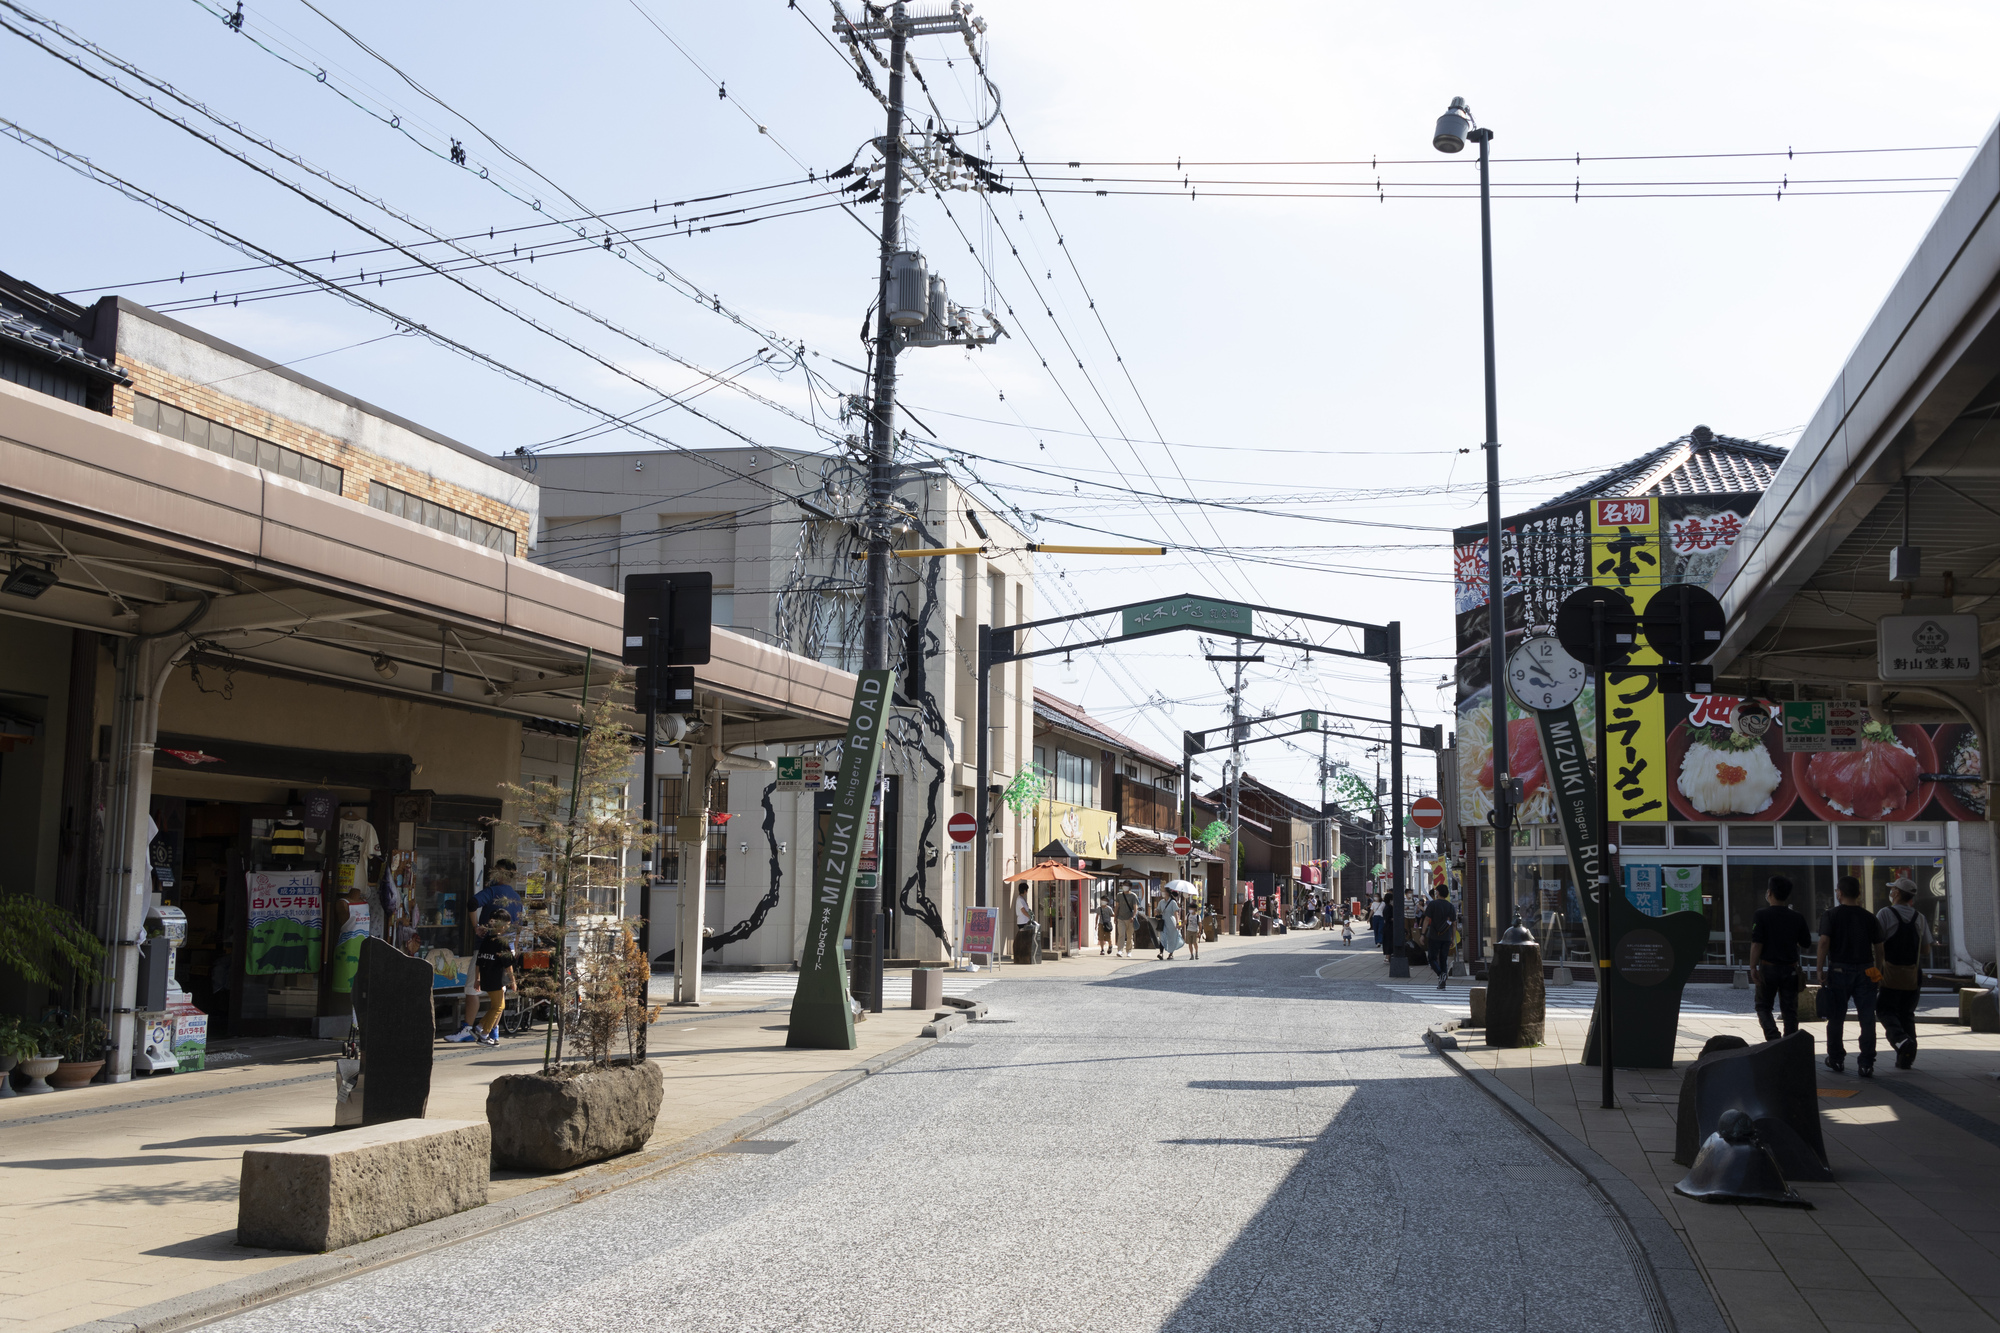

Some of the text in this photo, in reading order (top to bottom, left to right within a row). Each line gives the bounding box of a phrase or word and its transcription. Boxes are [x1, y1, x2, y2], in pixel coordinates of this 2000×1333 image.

[1603, 502, 1645, 523] 名物
[1673, 513, 1743, 552] 境港
[1573, 510, 1589, 592] 鳥取県境港の
[1459, 559, 1478, 581] 祝
[1520, 523, 1535, 645] 全国有数のマグロ水揚げを
[1541, 645, 1553, 656] 12
[1516, 670, 1525, 681] 9
[1569, 668, 1578, 679] 3
[1543, 693, 1552, 704] 6
[1549, 721, 1586, 795] MIZUKI
[1573, 800, 1589, 840] Shigeru
[821, 678, 881, 905] MIZUKI Shigeru ROAD
[290, 877, 313, 886] 大山
[253, 897, 320, 909] 白バラ牛乳
[814, 907, 831, 971] 水木しげるロード
